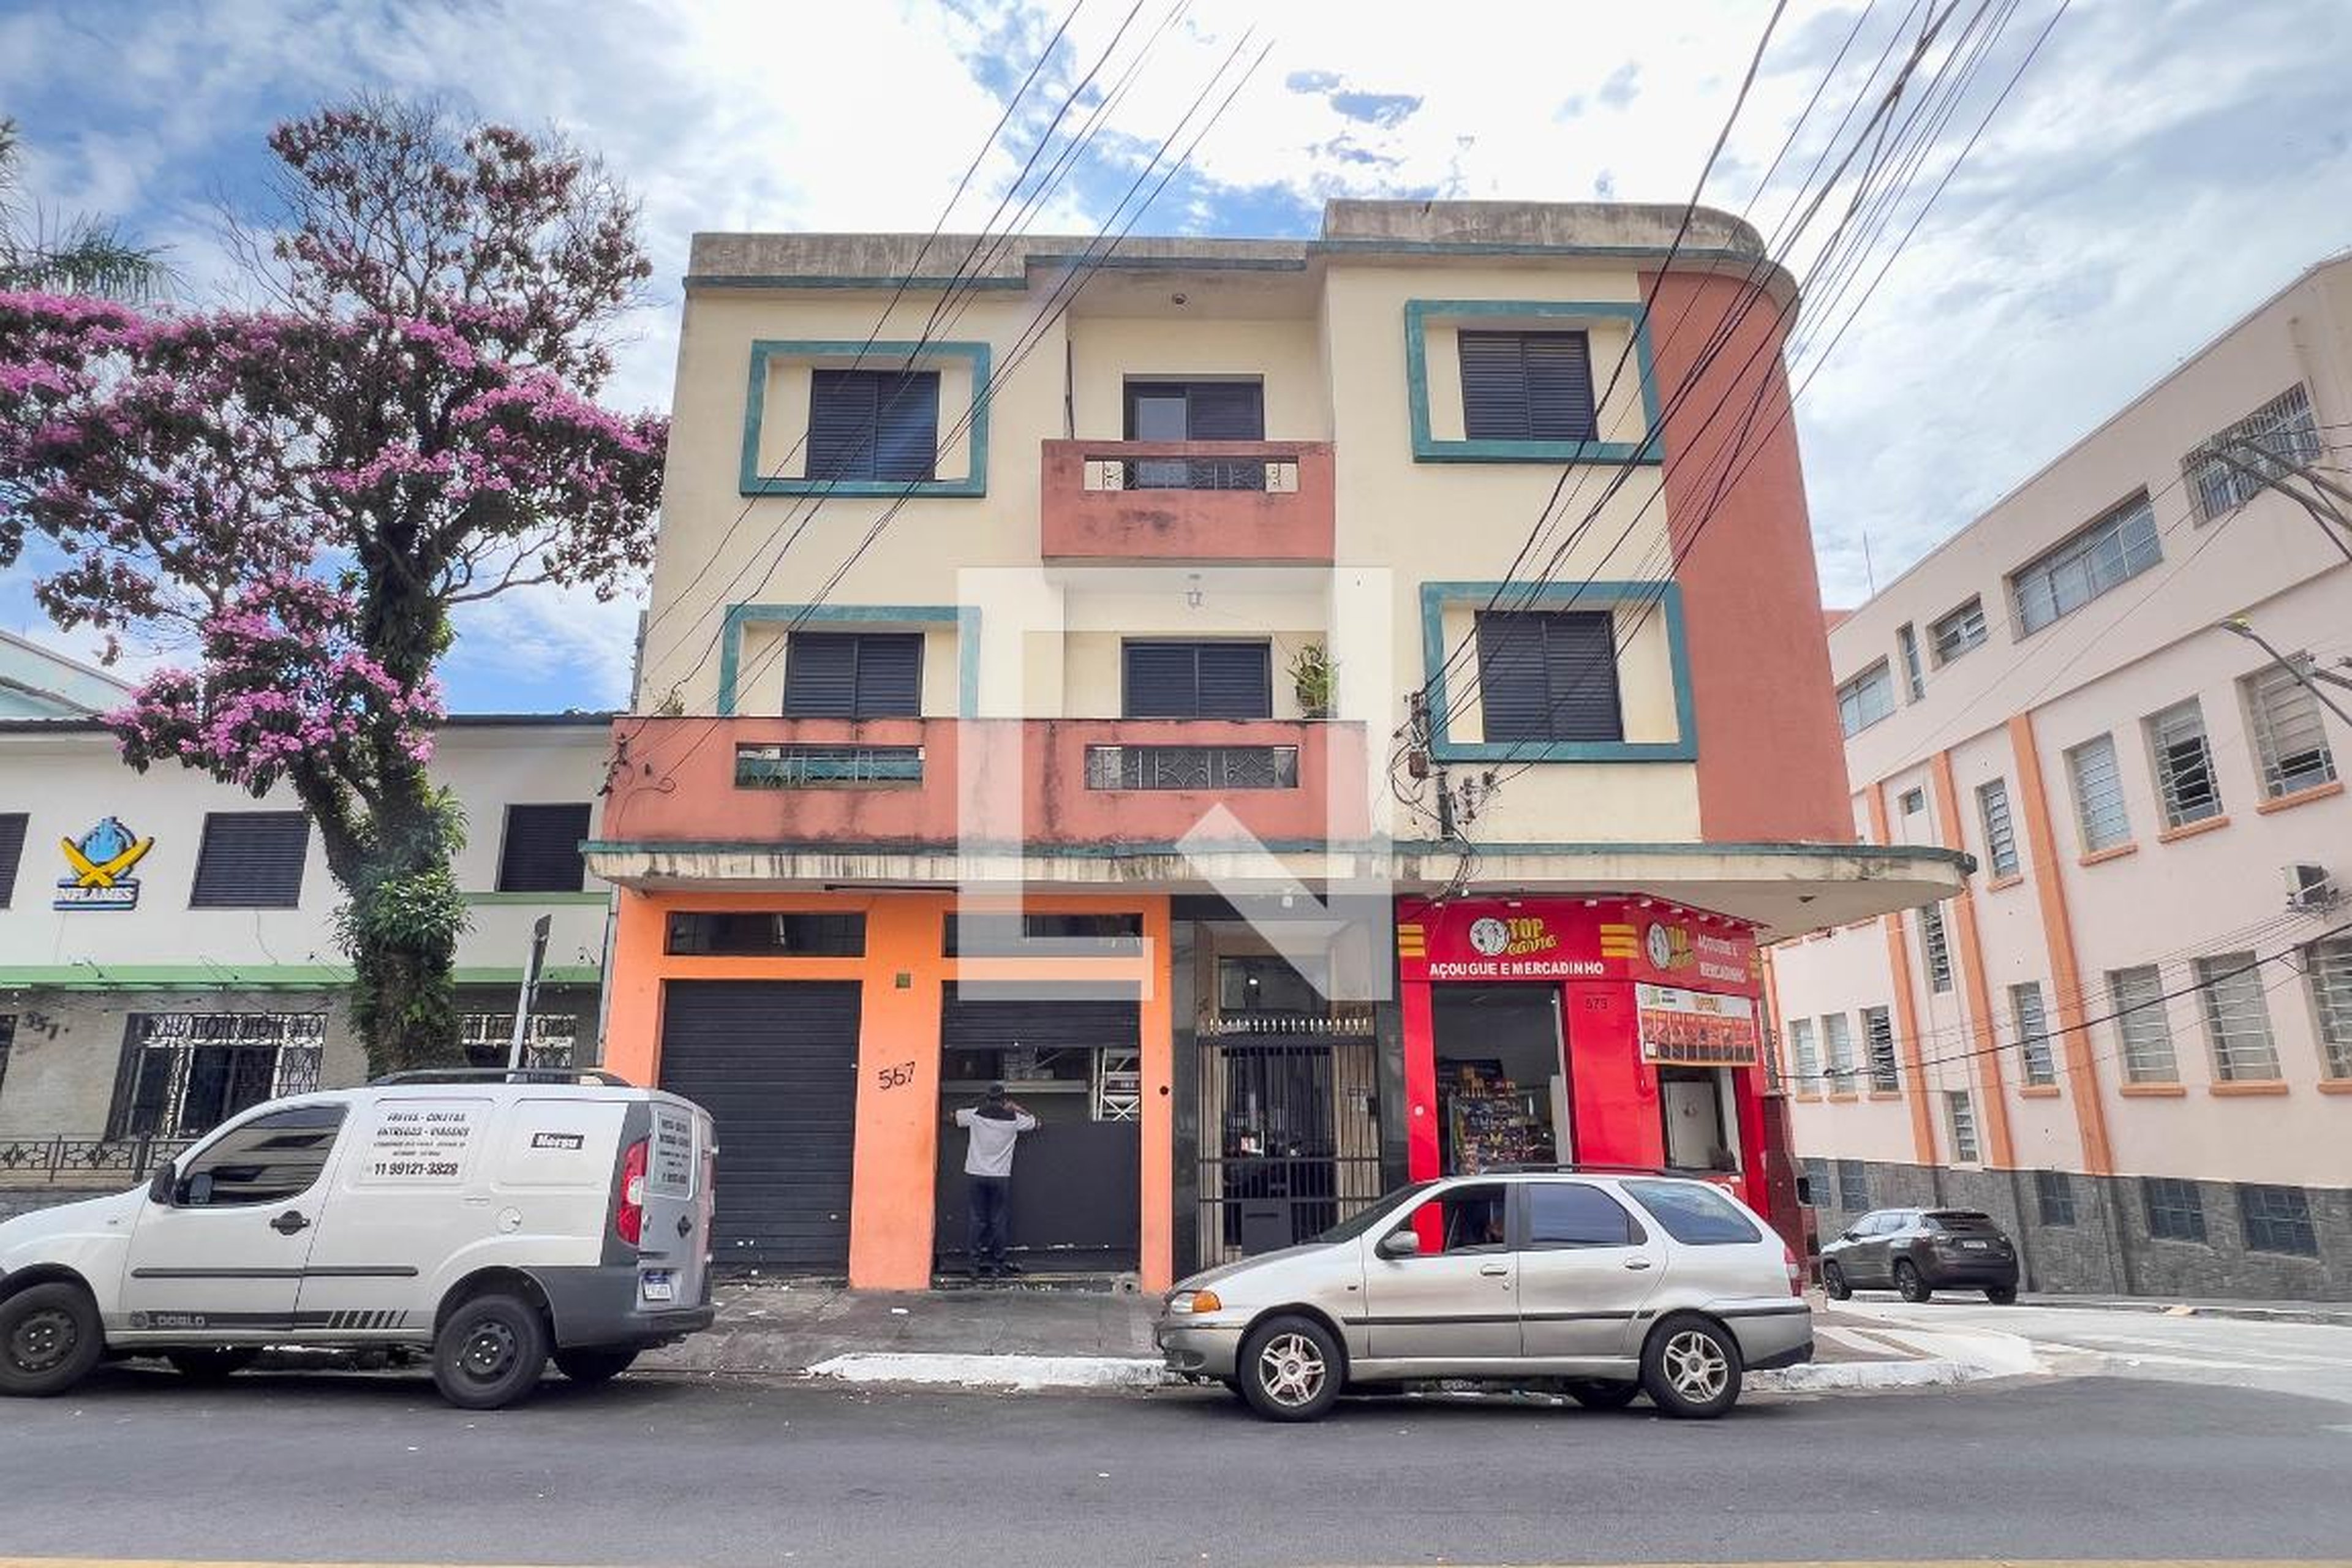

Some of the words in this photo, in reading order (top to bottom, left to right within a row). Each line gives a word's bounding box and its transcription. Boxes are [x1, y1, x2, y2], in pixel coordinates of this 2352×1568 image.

[1508, 919, 1544, 938] TOP
[1430, 962, 1497, 978] AÇOUGUE
[1501, 962, 1509, 975] E
[1512, 961, 1604, 975] MERCADINHO
[878, 1061, 916, 1090] 567
[374, 1162, 386, 1175] 11
